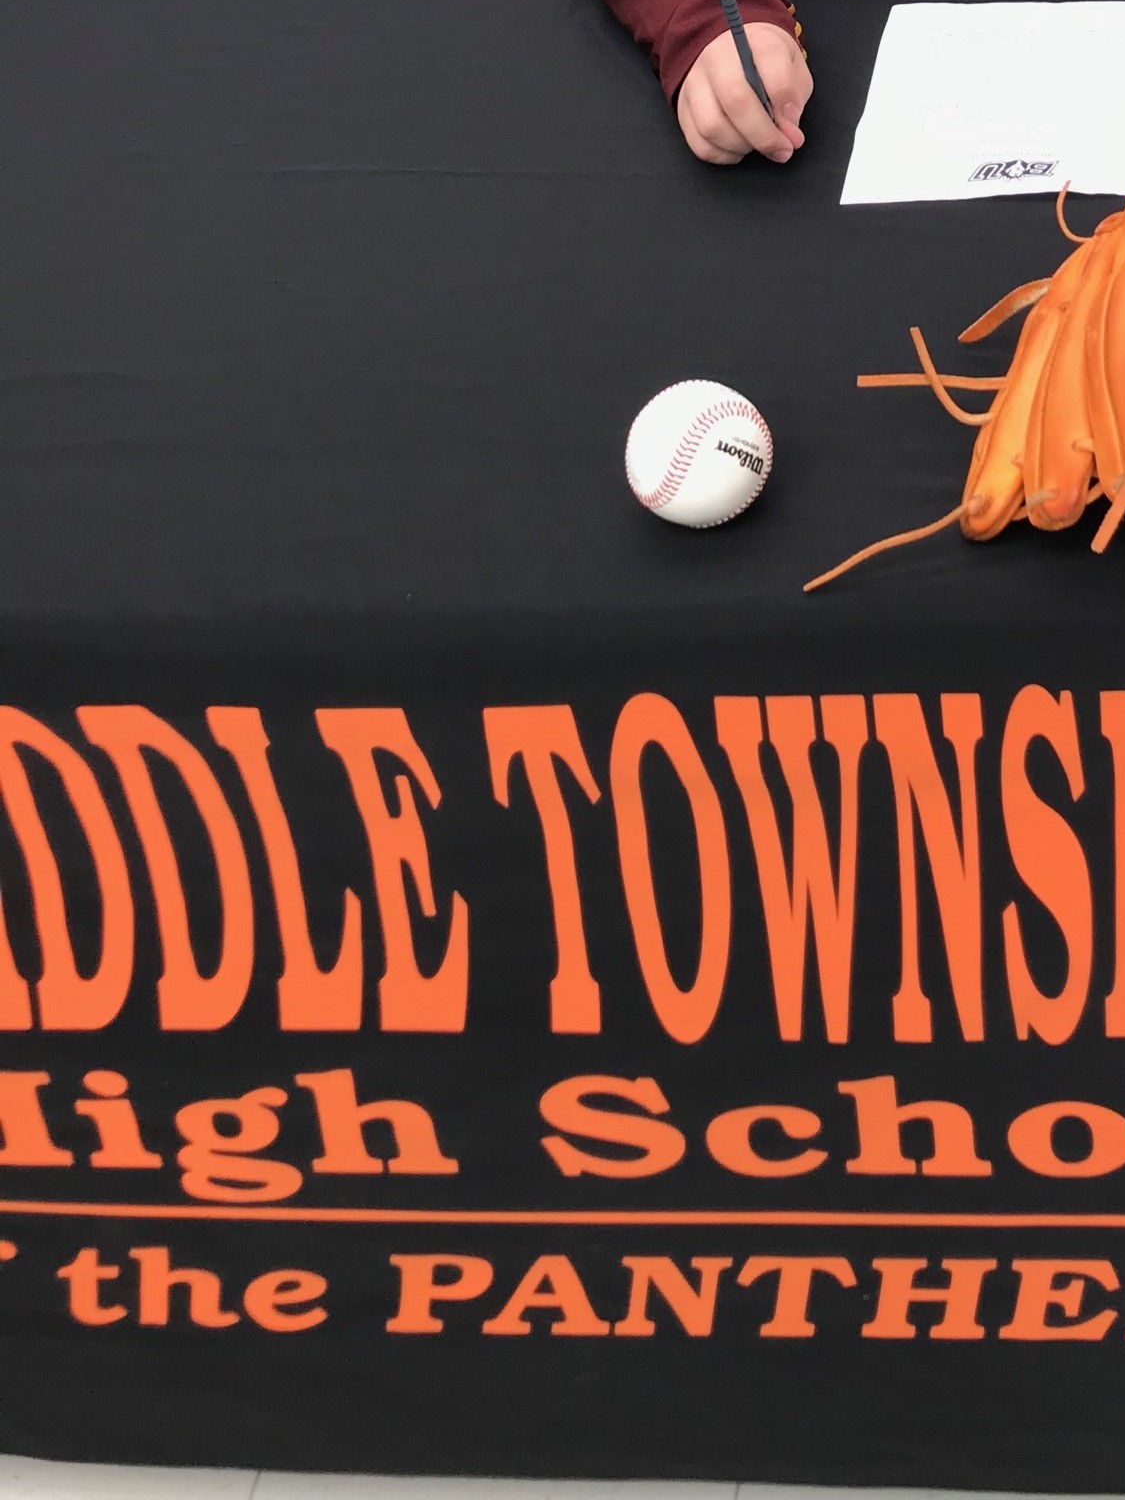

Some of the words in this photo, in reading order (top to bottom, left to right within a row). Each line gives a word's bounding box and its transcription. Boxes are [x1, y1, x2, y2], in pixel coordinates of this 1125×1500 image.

[716, 440, 764, 475] Wilson
[0, 705, 468, 1034] DDLE
[57, 1247, 327, 1333] the
